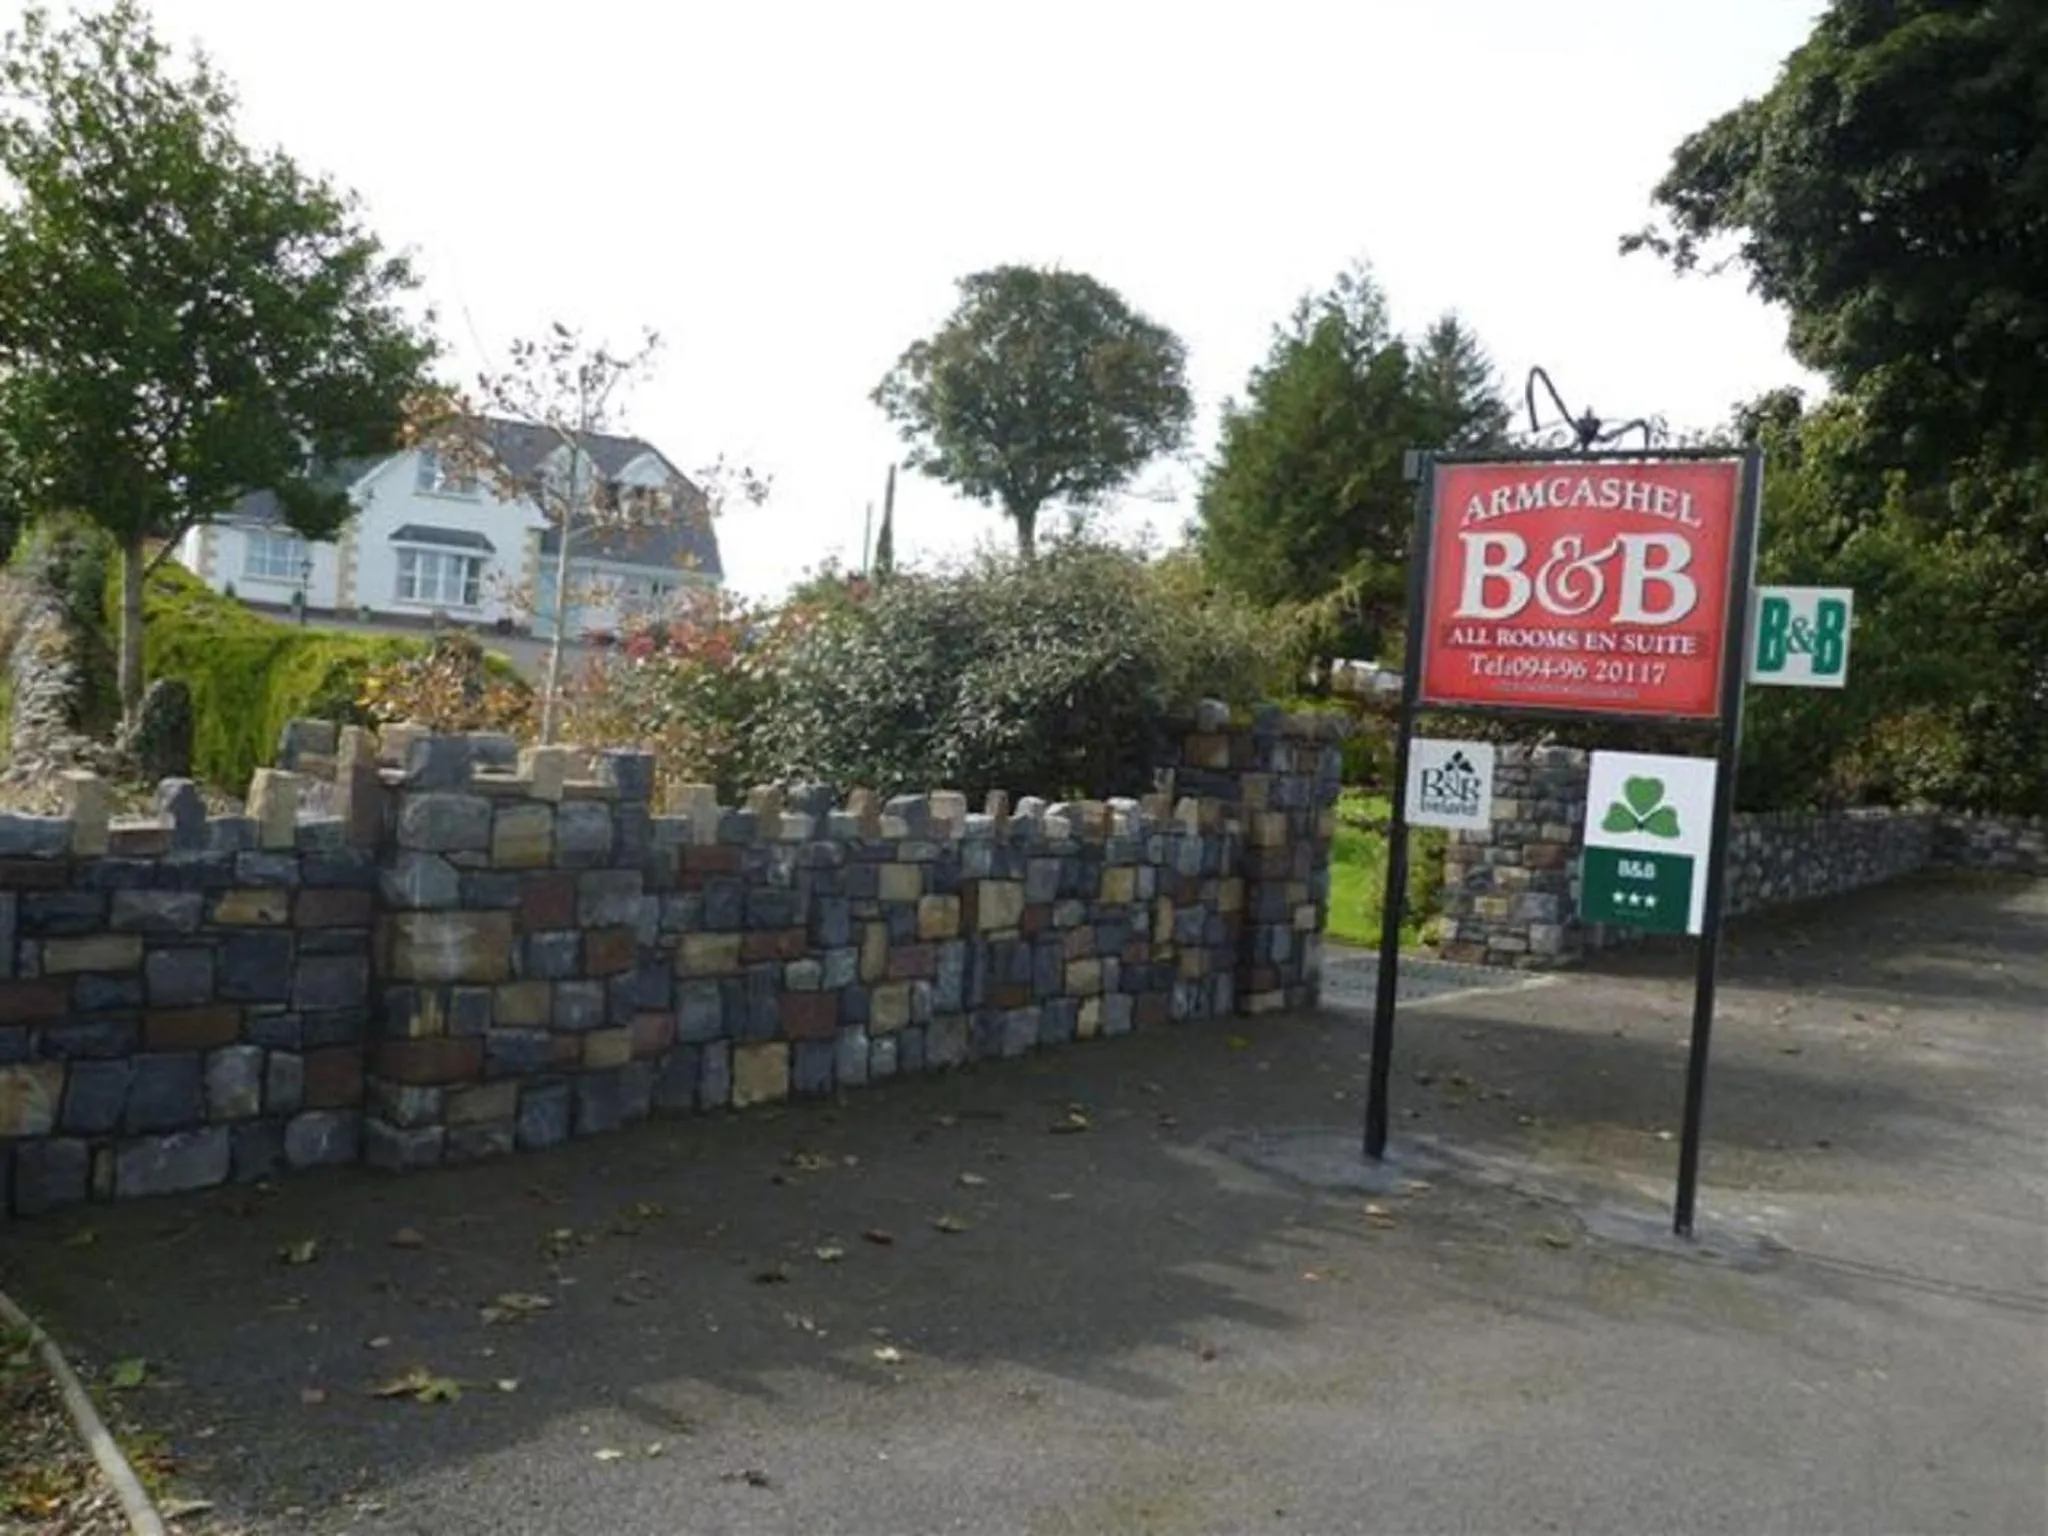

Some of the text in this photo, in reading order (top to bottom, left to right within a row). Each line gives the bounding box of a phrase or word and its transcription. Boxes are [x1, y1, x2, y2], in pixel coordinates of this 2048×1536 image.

[1460, 476, 1702, 528] ARMCASHEL
[1454, 532, 1698, 626] B&B
[1450, 628, 1697, 656] ALL ROOMS EN SUITE
[1757, 597, 1846, 675] B&B
[1595, 660, 1667, 686] 20117
[1421, 767, 1481, 801] B&B
